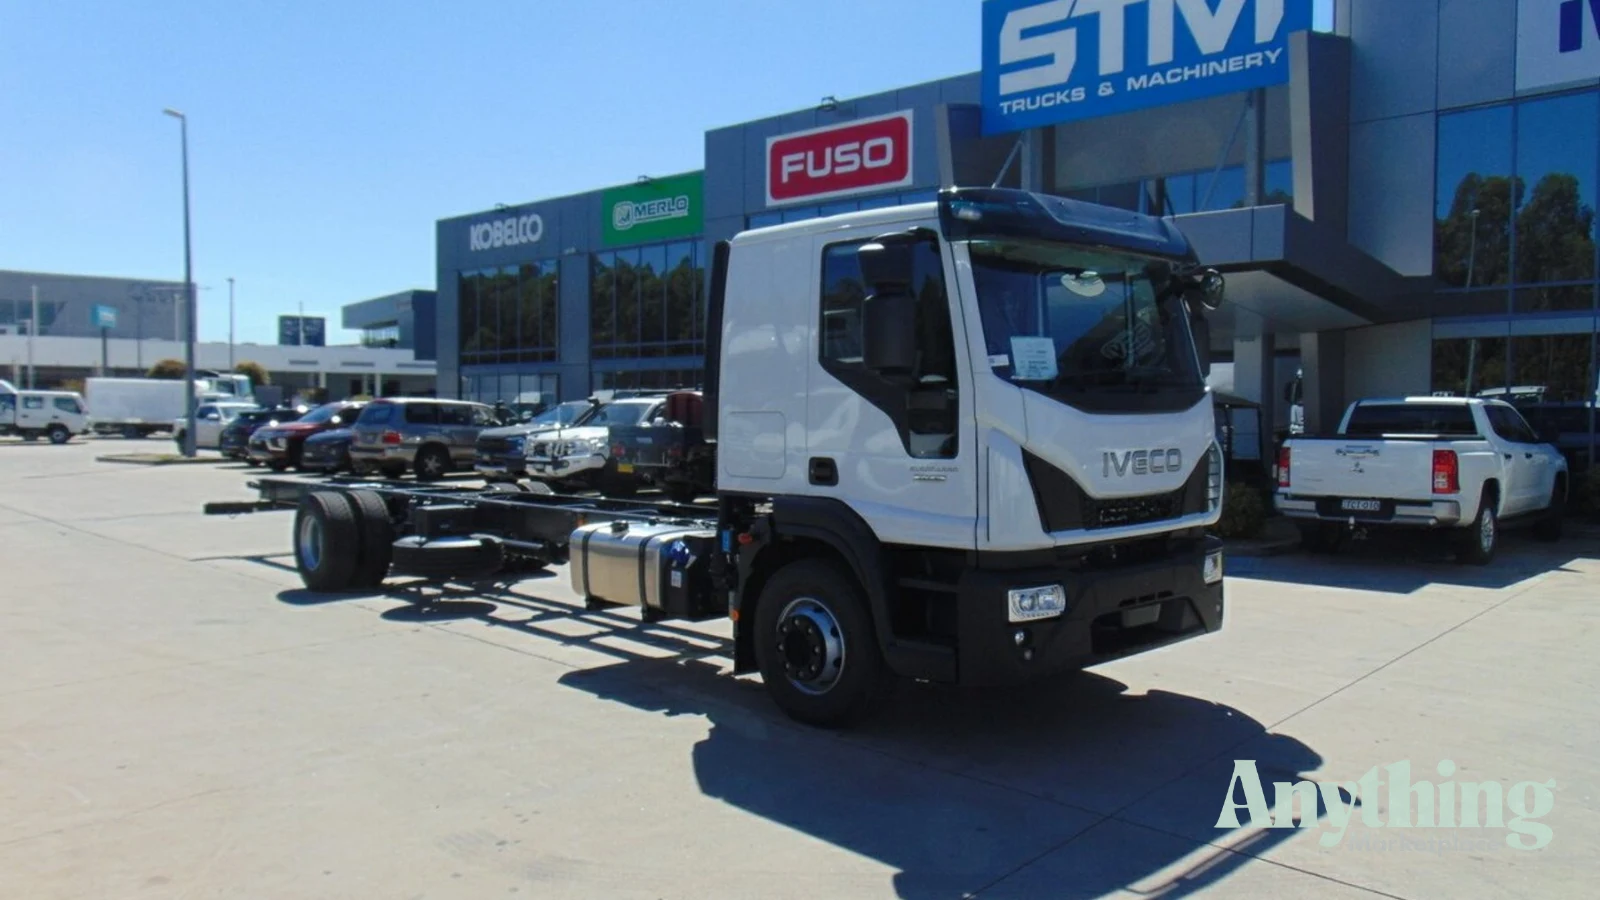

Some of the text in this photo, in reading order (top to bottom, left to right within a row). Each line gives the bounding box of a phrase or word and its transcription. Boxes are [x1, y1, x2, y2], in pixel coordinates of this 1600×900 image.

[1000, 0, 1284, 96] STM
[1000, 48, 1283, 115] TRUCKS & MACHINERY
[781, 136, 893, 184] FUSO
[633, 196, 688, 218] MERLO
[470, 214, 543, 251] KOBELCO
[1102, 448, 1182, 478] IVECO
